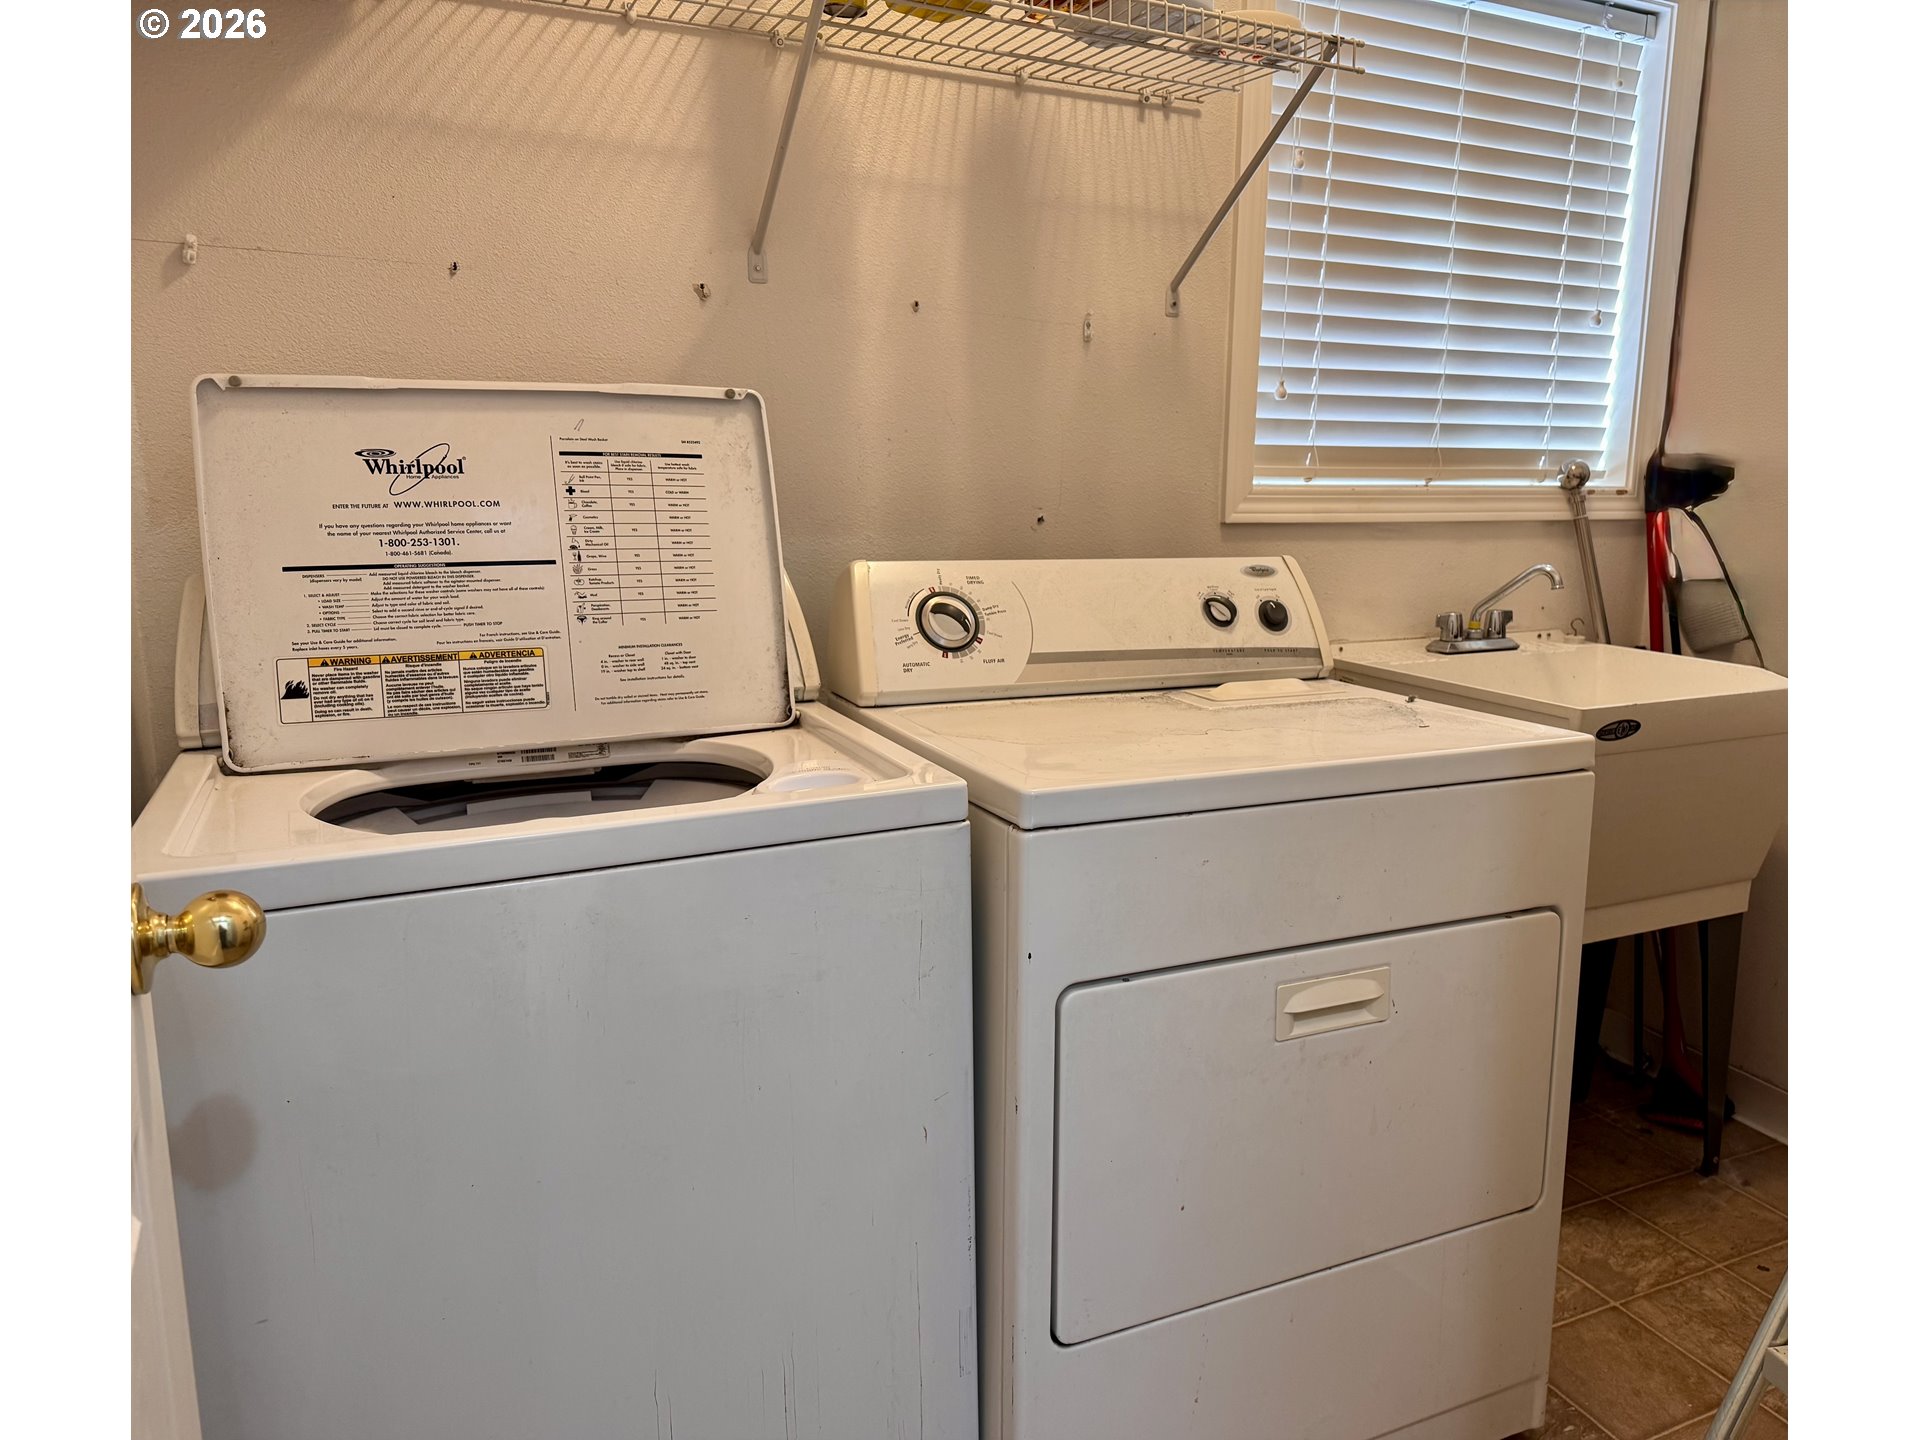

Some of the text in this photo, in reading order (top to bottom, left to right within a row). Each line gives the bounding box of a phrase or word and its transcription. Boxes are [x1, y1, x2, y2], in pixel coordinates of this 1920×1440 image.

[378, 538, 460, 548] 1-800-253-1301.
[895, 636, 914, 646] Preferred
[392, 653, 458, 663] AVERTISSEMENT
